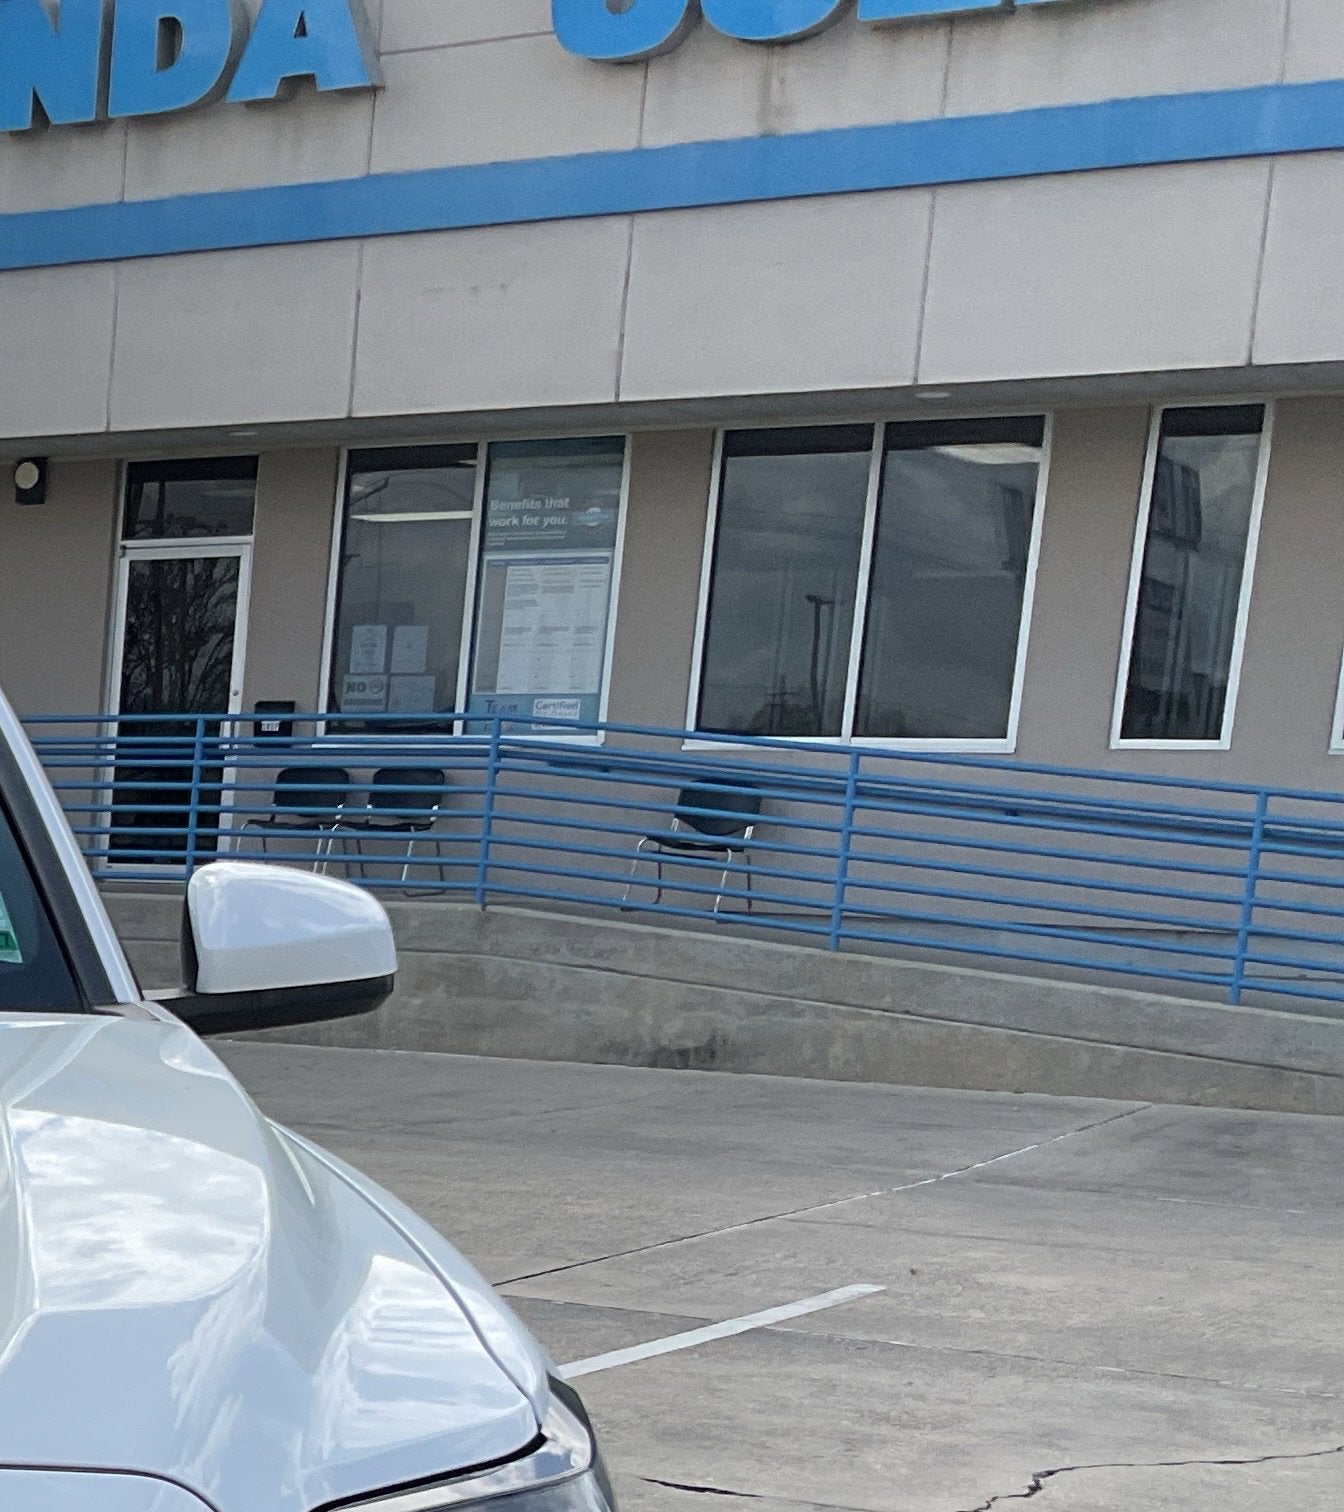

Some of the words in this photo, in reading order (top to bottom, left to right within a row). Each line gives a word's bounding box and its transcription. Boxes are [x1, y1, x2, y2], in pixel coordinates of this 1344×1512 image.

[490, 498, 541, 510] Benefits
[545, 497, 569, 509] that
[489, 515, 520, 527] work
[522, 514, 541, 526] for
